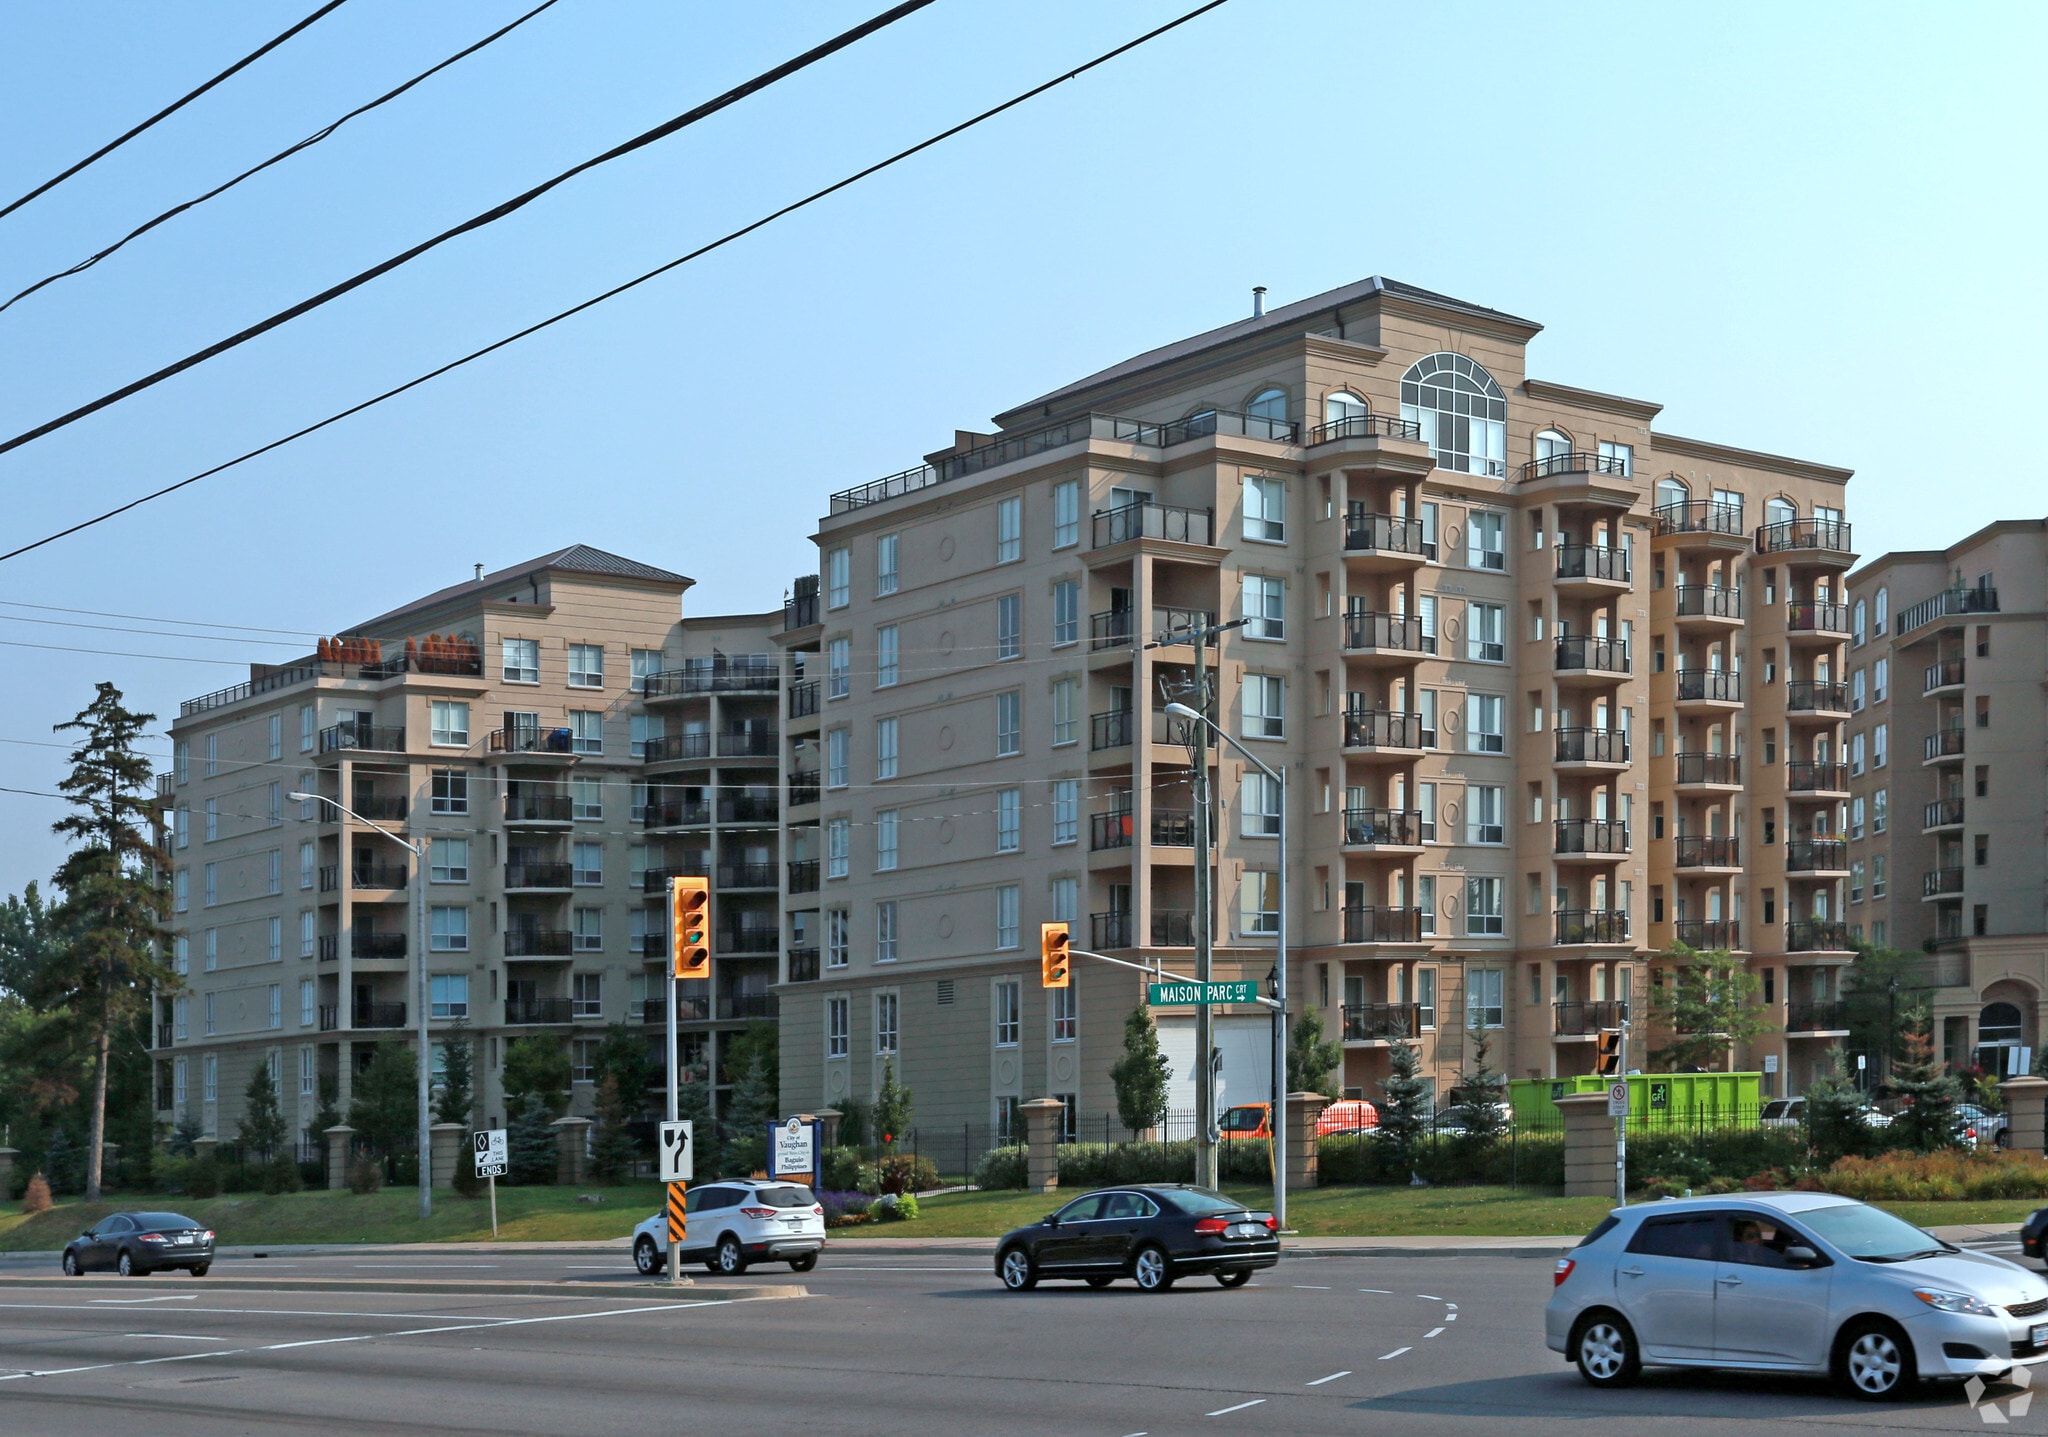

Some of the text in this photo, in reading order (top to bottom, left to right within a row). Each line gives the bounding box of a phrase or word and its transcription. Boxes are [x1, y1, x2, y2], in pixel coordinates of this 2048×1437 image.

[1160, 984, 1247, 1002] MAISON PARC CRT
[1652, 1092, 1664, 1101] GFL
[779, 1140, 808, 1150] Vaughan
[784, 1156, 804, 1164] Baguio
[482, 1165, 502, 1176] ENDS
[781, 1163, 807, 1171] Philippines
